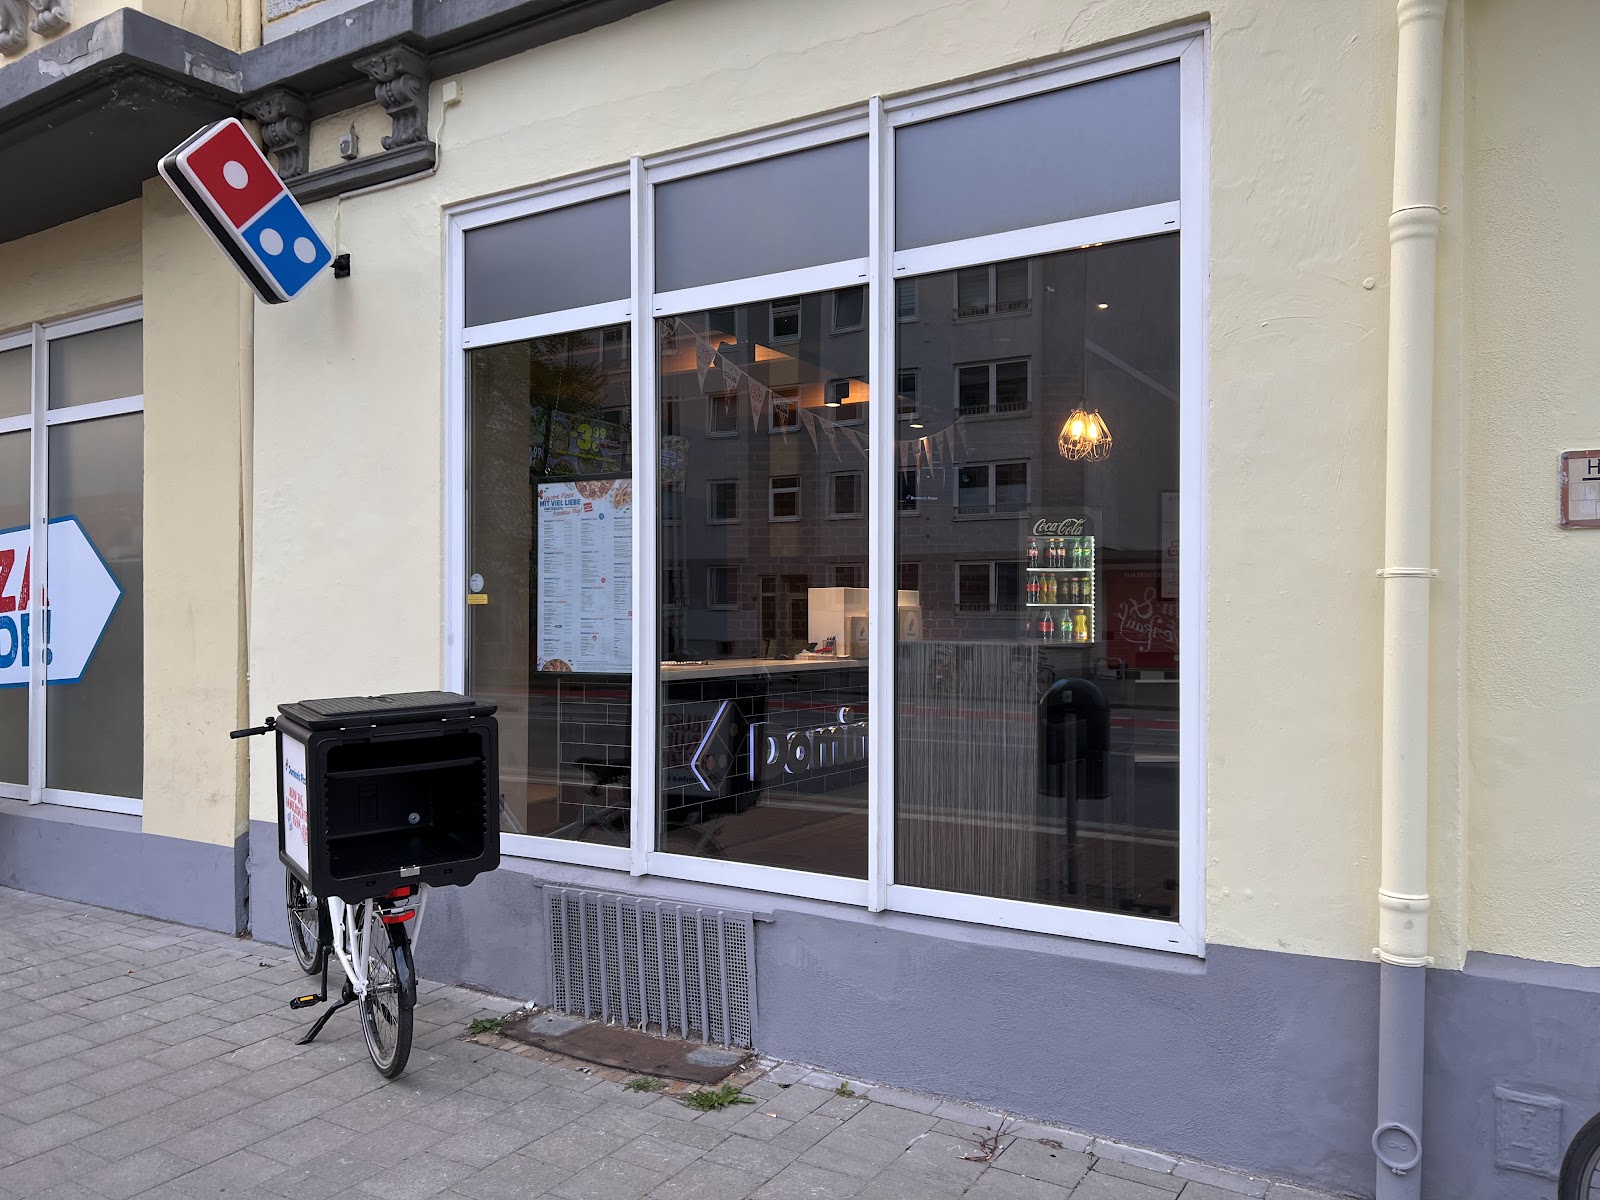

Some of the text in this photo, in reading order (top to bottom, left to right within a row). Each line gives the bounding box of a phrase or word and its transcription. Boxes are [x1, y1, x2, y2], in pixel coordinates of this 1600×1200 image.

[540, 498, 581, 507] MIT VIEL LIEBE
[1033, 518, 1086, 535] Coca-Cola
